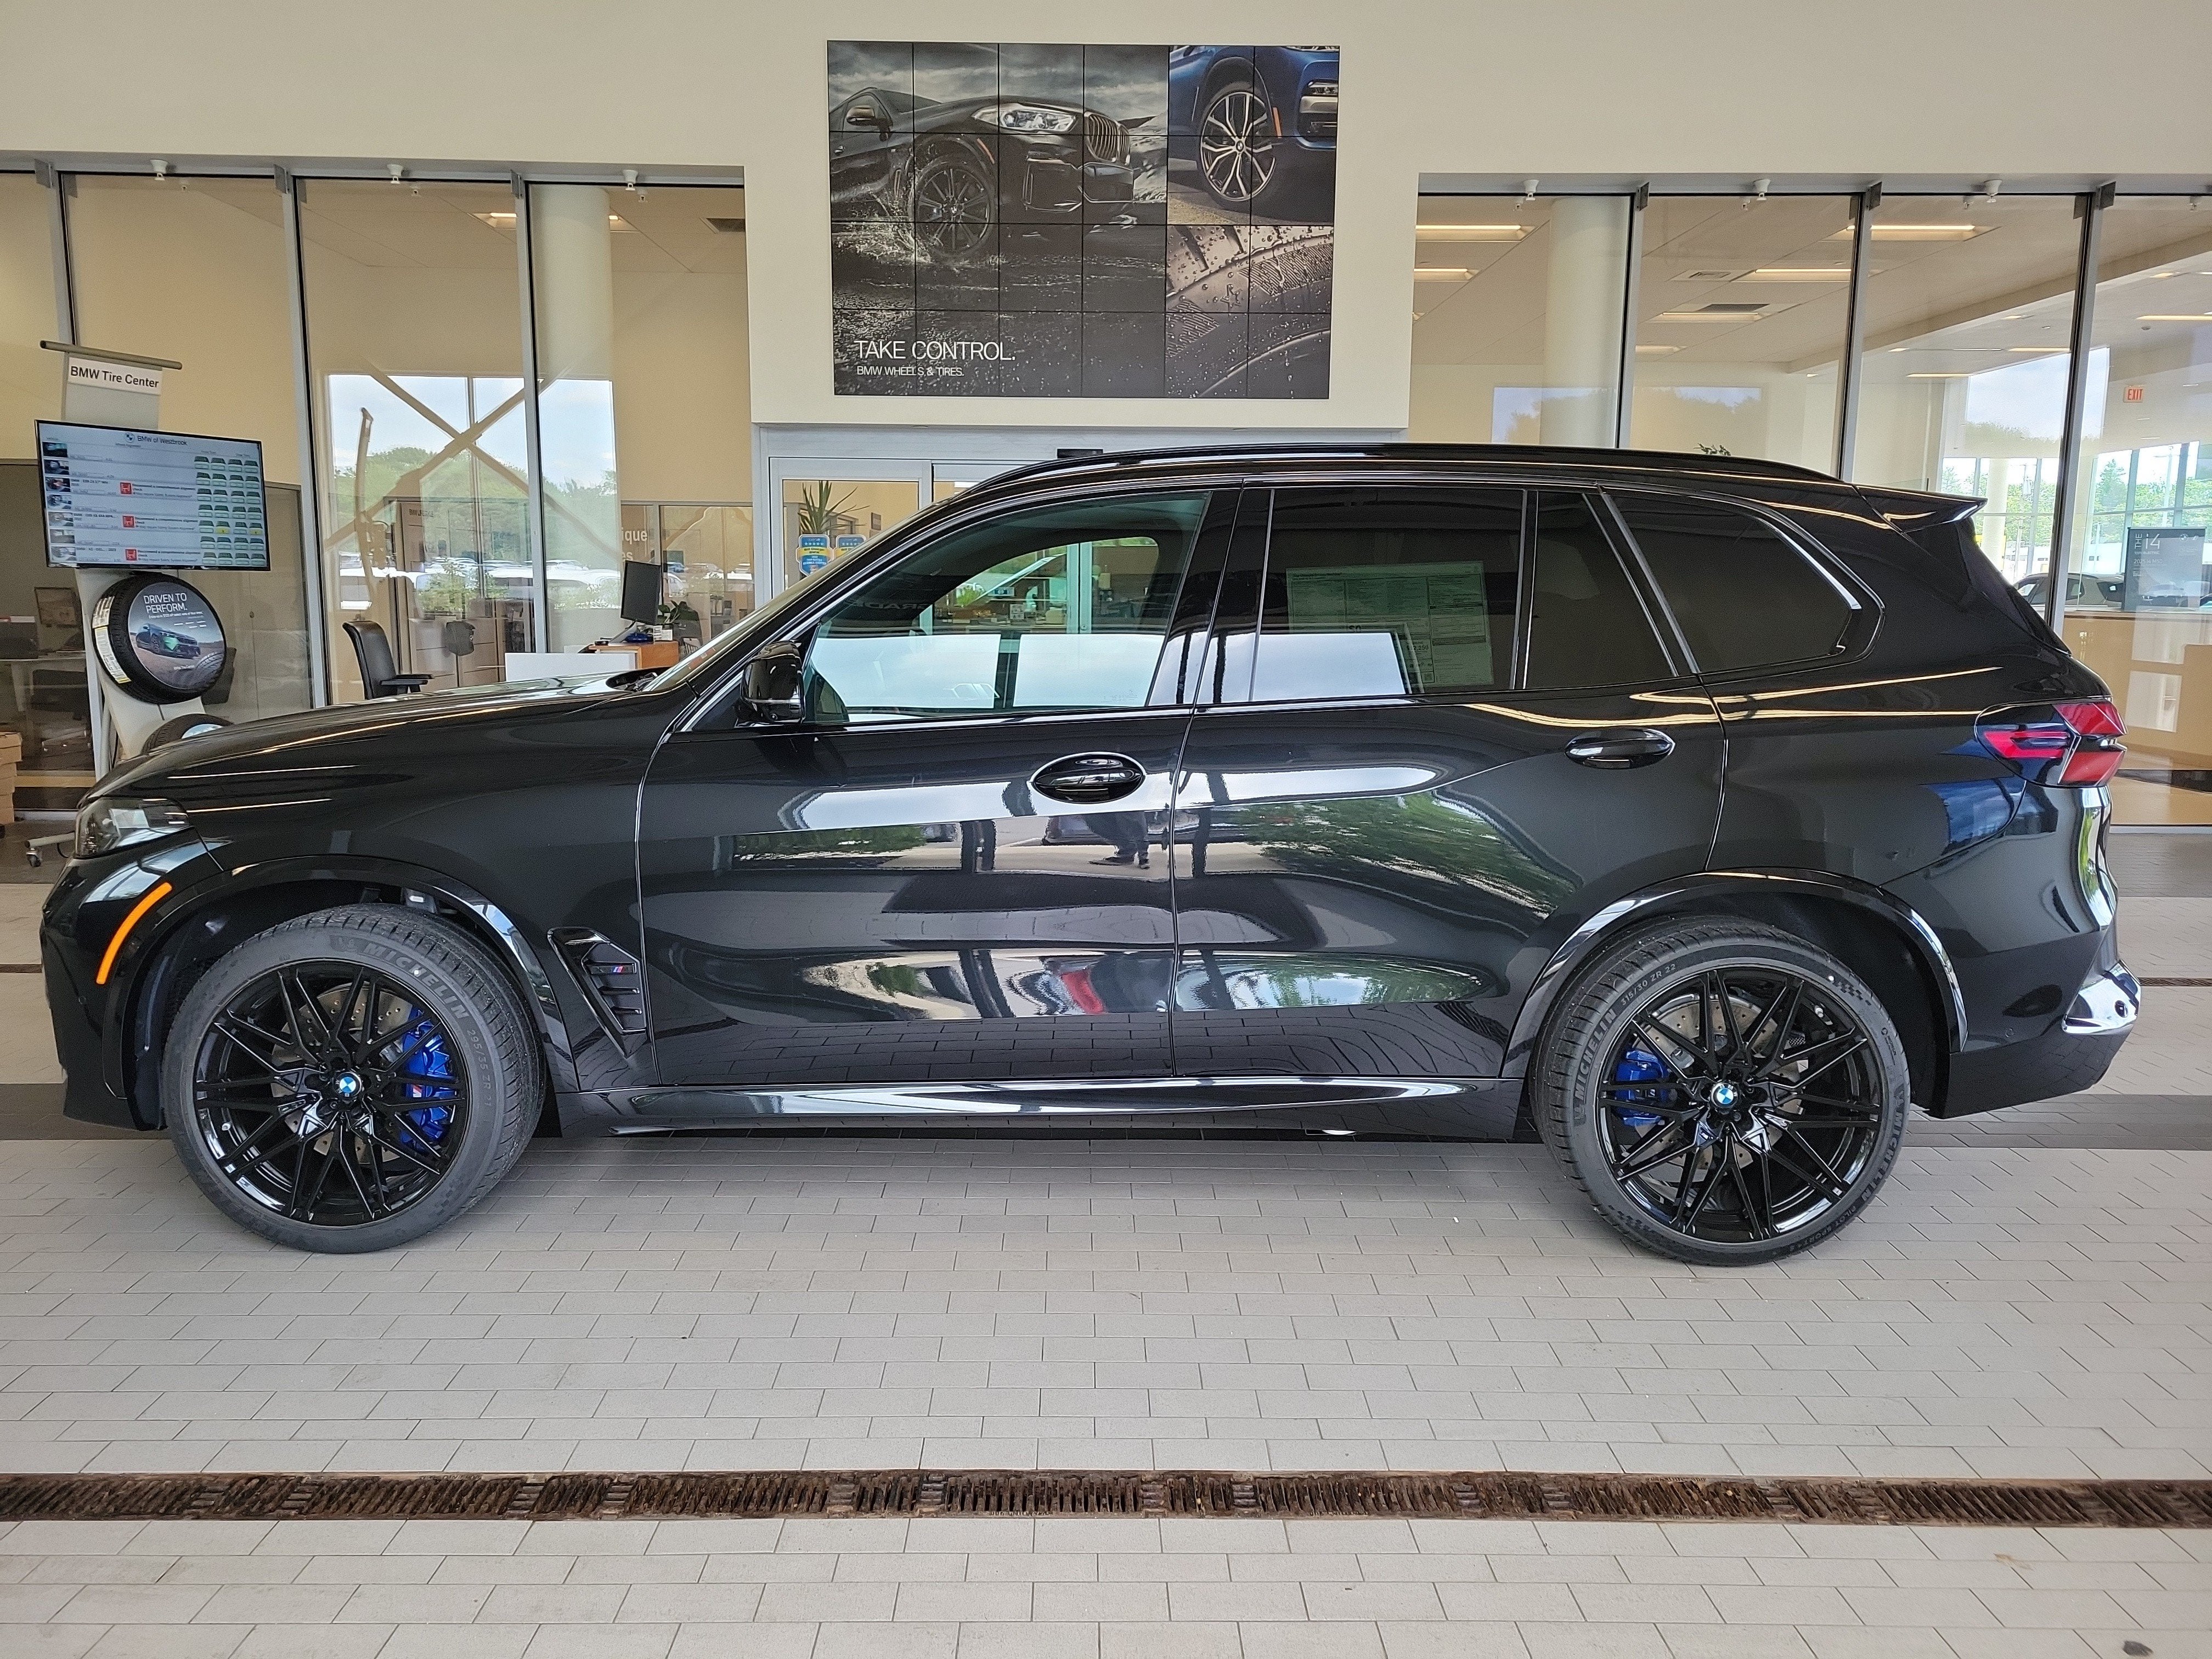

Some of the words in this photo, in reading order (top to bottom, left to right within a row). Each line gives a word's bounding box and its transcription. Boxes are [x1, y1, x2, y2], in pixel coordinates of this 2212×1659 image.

[853, 340, 906, 359] TAKE
[911, 340, 1016, 360] CONTROL.
[70, 365, 100, 380] BMW
[101, 370, 122, 383] Tire
[125, 374, 159, 388] Center
[857, 365, 883, 375] BMW
[884, 366, 924, 376] WHEELS
[926, 367, 934, 376] &
[936, 366, 964, 376] TIRES.
[2128, 388, 2143, 400] EXIT
[2134, 533, 2142, 549] THE
[2145, 533, 2160, 550] i4
[143, 594, 174, 604] DRIVEN
[175, 592, 187, 602] TO
[145, 602, 188, 614] PERFORM.
[363, 943, 470, 1019] MICHELIN
[1621, 979, 1648, 1006] 315/30
[1650, 970, 1663, 982] ZR
[1664, 963, 1677, 974] 22
[466, 1029, 488, 1074] 295/35
[482, 1077, 492, 1090] ZR
[1575, 1008, 1617, 1102] MICHELIN
[1861, 1111, 1904, 1202] MICHELIN
